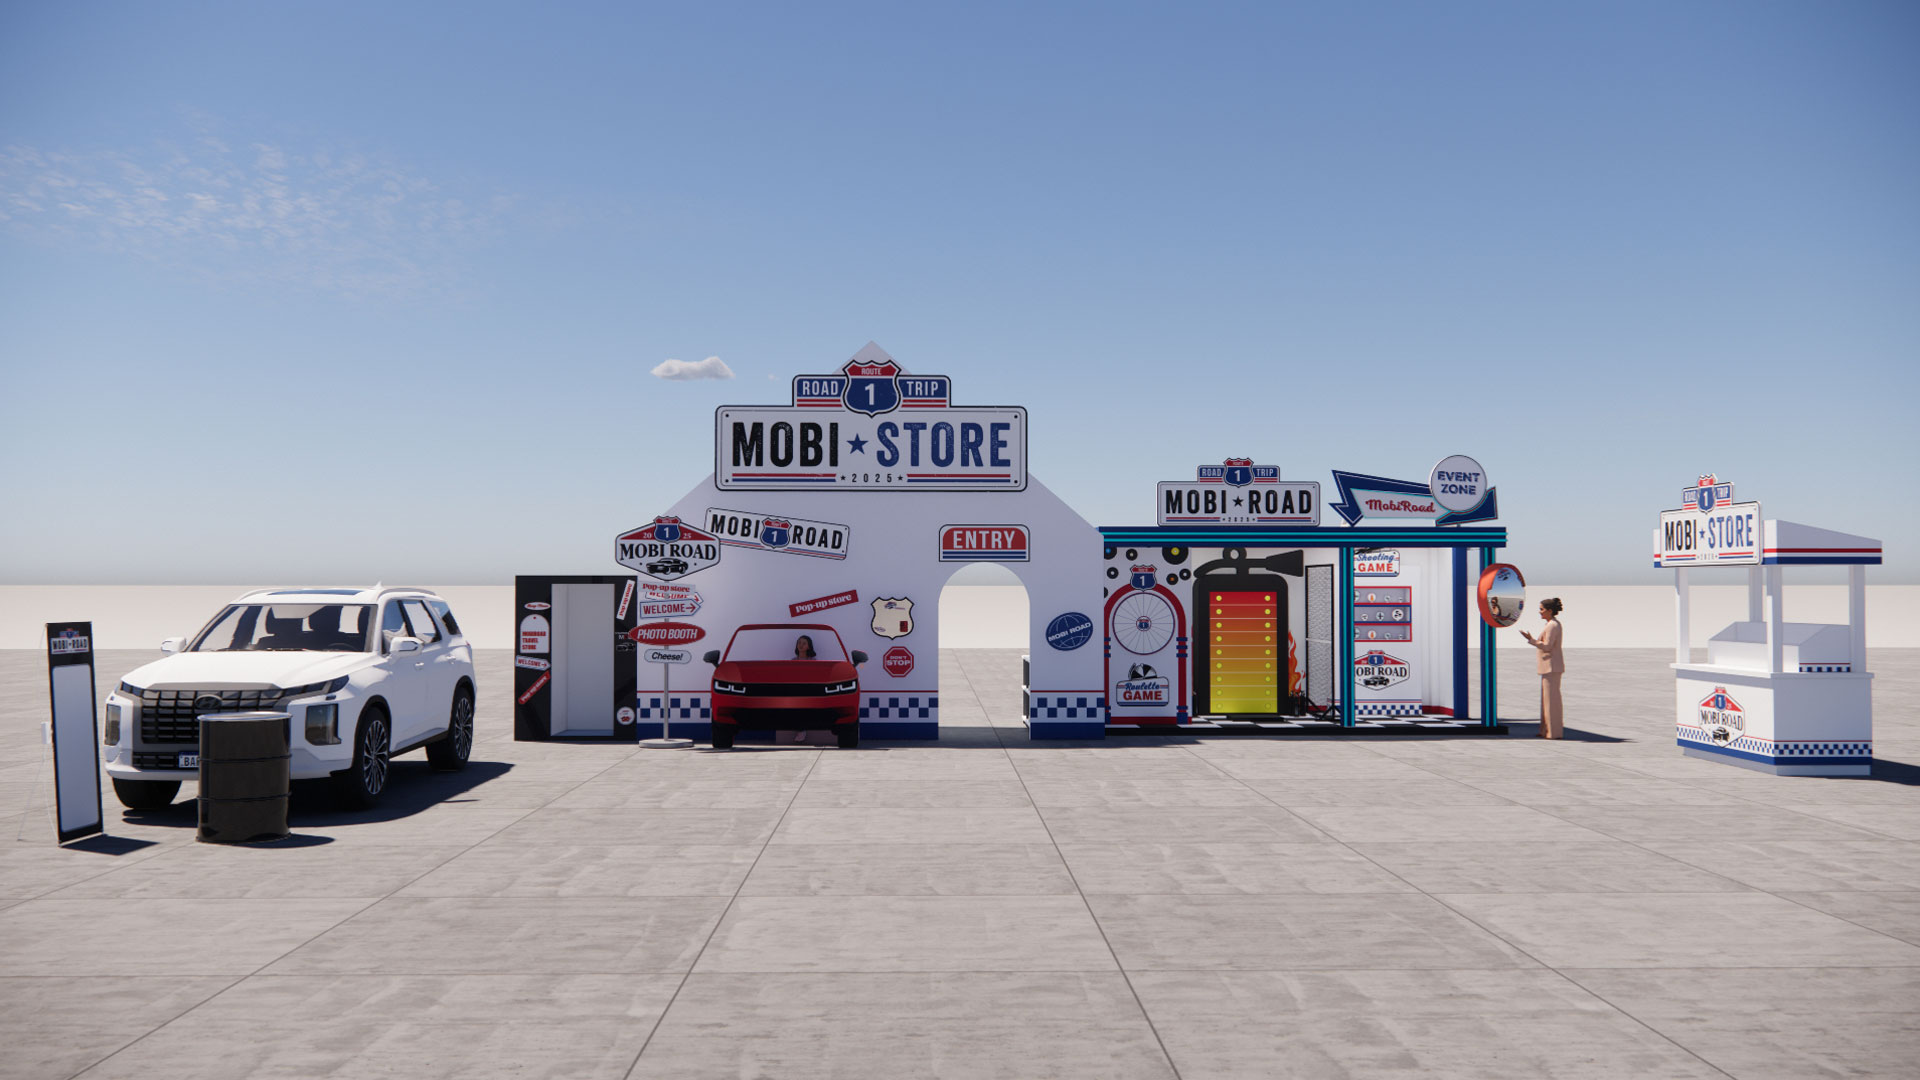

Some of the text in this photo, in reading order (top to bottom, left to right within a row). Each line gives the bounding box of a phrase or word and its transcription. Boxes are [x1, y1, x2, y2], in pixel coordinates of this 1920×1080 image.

[802, 380, 938, 406] ROAD 1 TRIP
[732, 421, 1011, 468] MOBI STORE
[852, 474, 892, 483] 2025
[1202, 468, 1274, 482] ROAD 1 TRIP
[1438, 471, 1480, 483] EVENT
[1441, 484, 1476, 495] ZONE
[1166, 490, 1311, 514] MOBI ROAD
[1704, 491, 1708, 507] 1
[1365, 499, 1435, 512] MobiRoad
[664, 527, 669, 538] 1
[710, 514, 843, 549] MOBI 1 ROAD
[1665, 514, 1753, 551] MOBI STORE
[953, 530, 1015, 548] ENTRY
[620, 543, 716, 560] MOBI ROAD
[1356, 554, 1394, 563] Shooting
[1358, 563, 1393, 572] GAME
[1140, 576, 1145, 586] 1
[642, 583, 669, 591] Pop-up
[643, 603, 685, 614] WELCOME
[796, 594, 852, 613] Pop-up store
[1069, 622, 1091, 633] ROAD
[637, 629, 666, 640] PHOTO
[668, 629, 698, 640] BOOTH
[652, 652, 683, 660] Cheese!
[1354, 666, 1407, 677] OBI ROAD
[1123, 691, 1162, 700] GAME
[1701, 710, 1743, 731] MOBI ROAD
